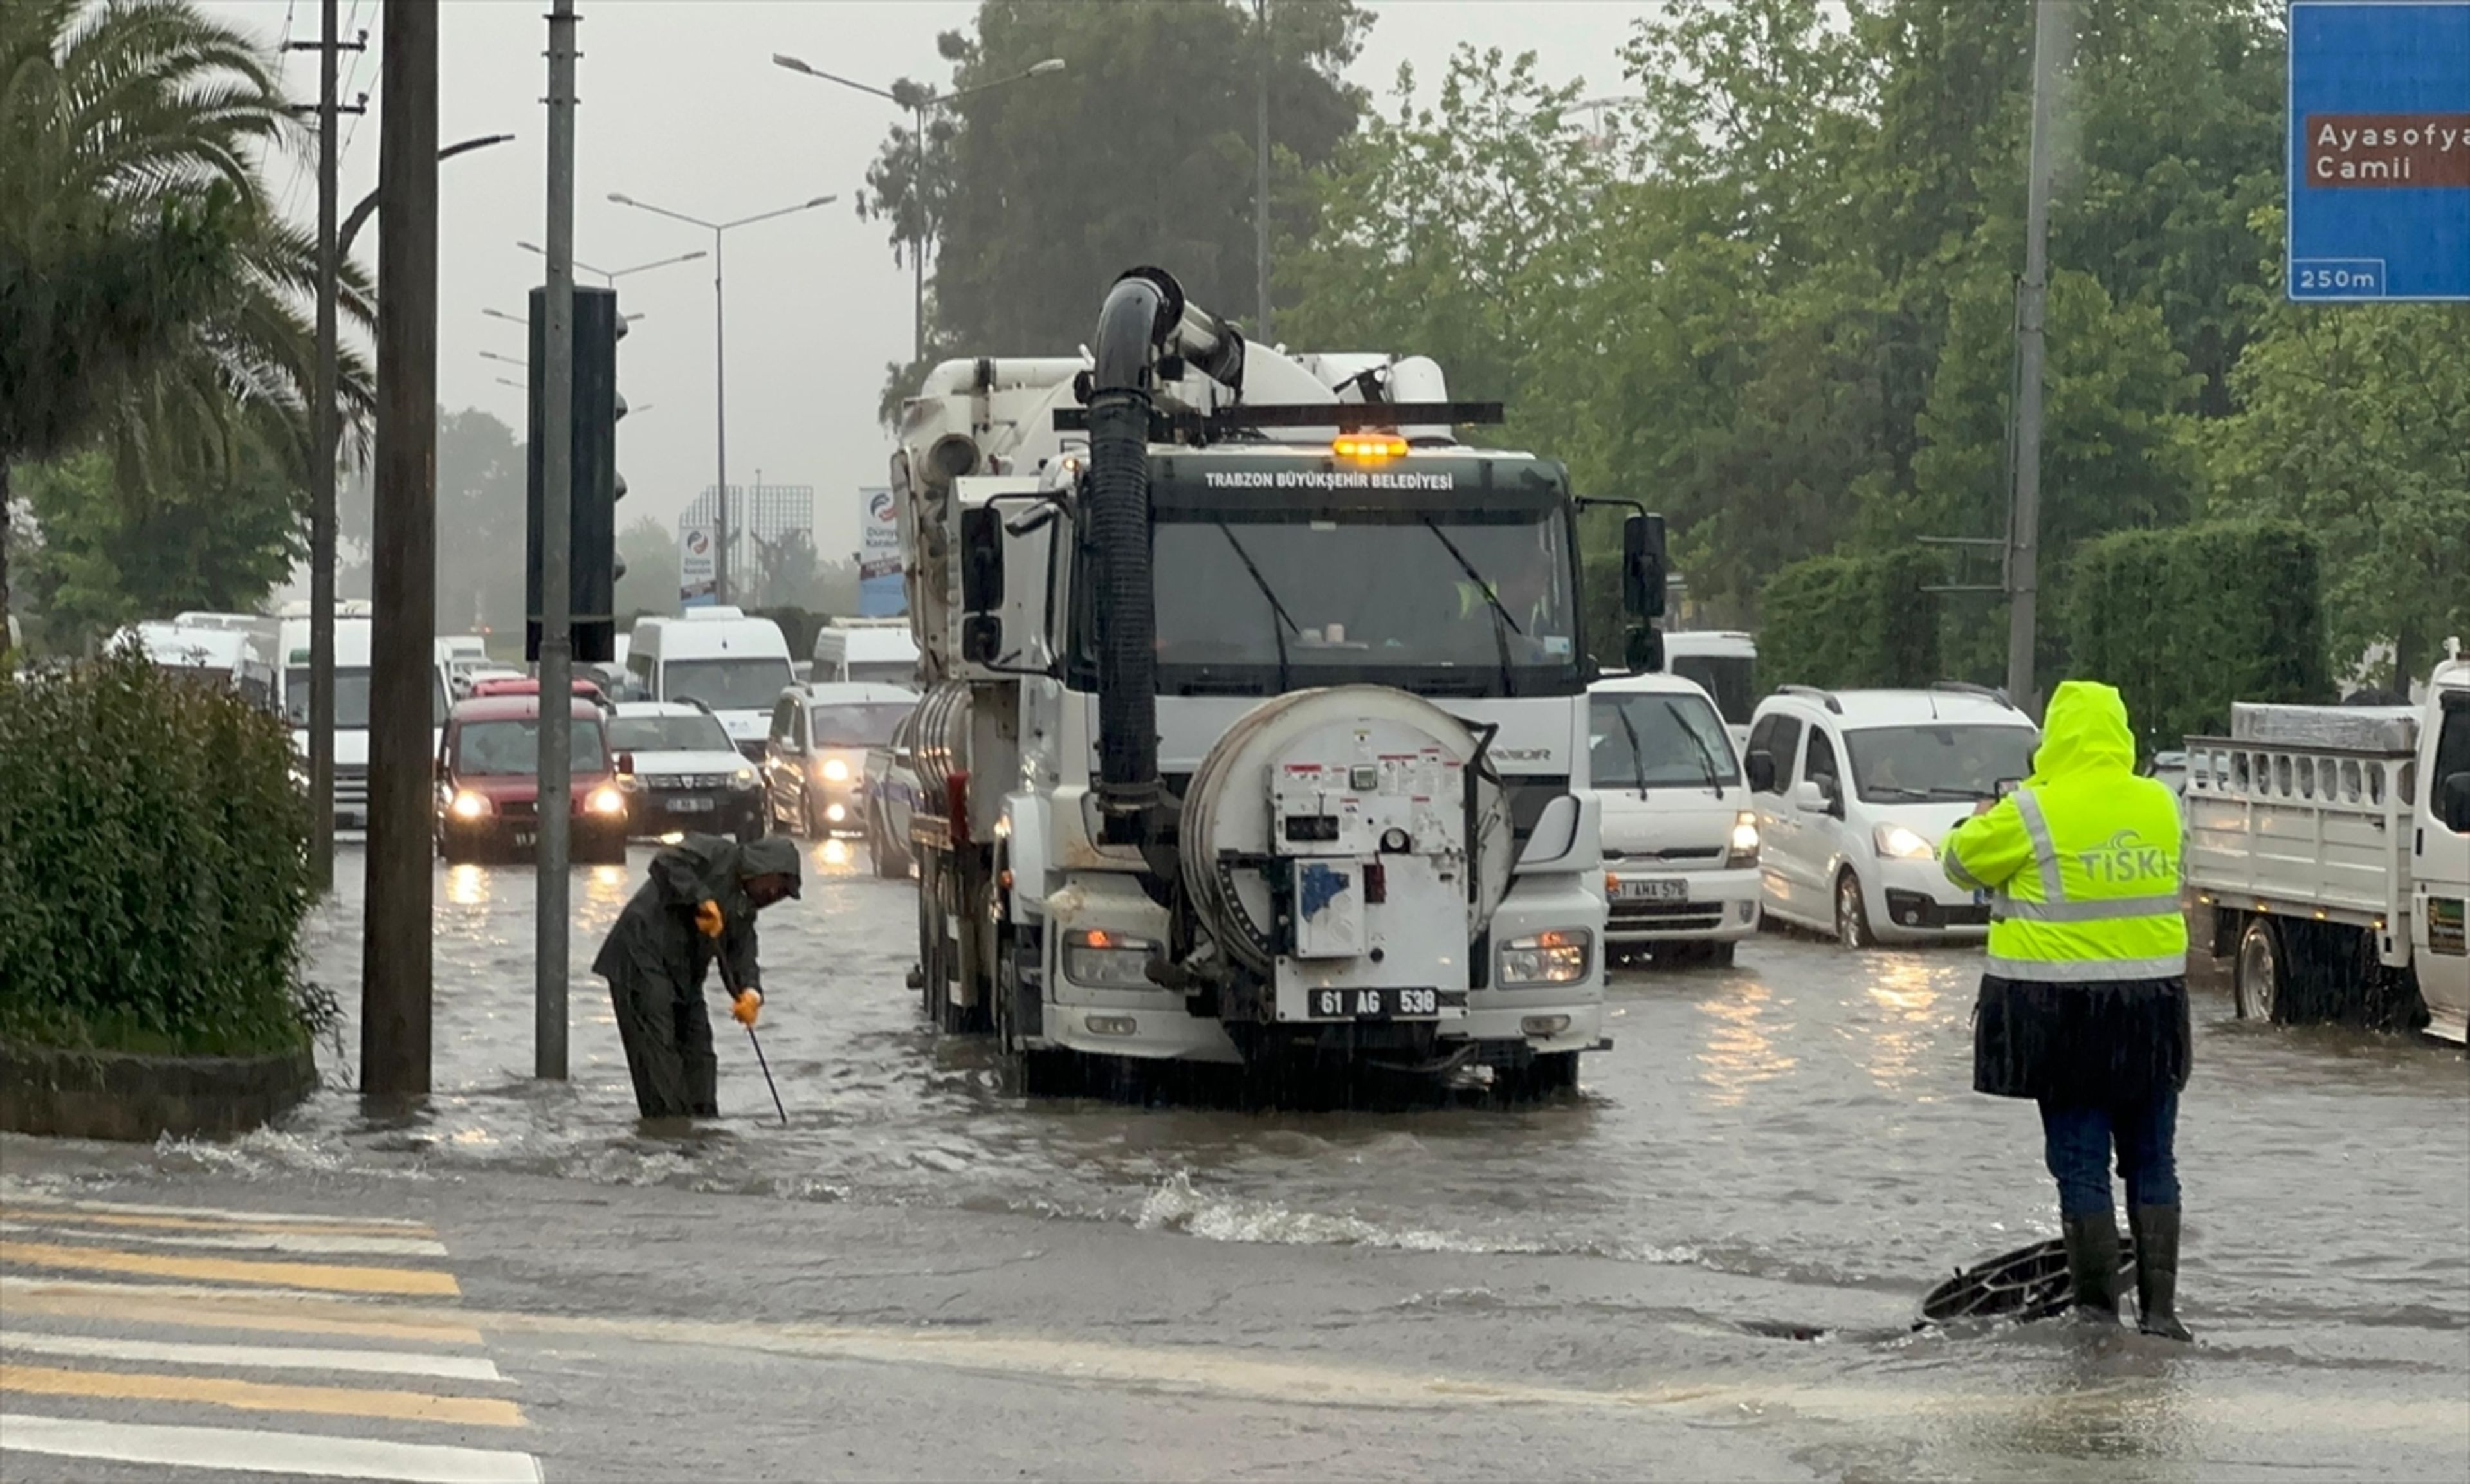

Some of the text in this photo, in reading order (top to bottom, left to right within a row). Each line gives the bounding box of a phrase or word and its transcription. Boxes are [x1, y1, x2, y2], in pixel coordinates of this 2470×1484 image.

[2318, 123, 2470, 152] Ayasofya
[2317, 156, 2410, 179] Camii
[2301, 270, 2374, 288] 250m
[1205, 470, 1453, 491] TRABZON BÜYÜKŞEHİR BELEDİYESİ
[1321, 989, 1435, 1014] 61 AG 538
